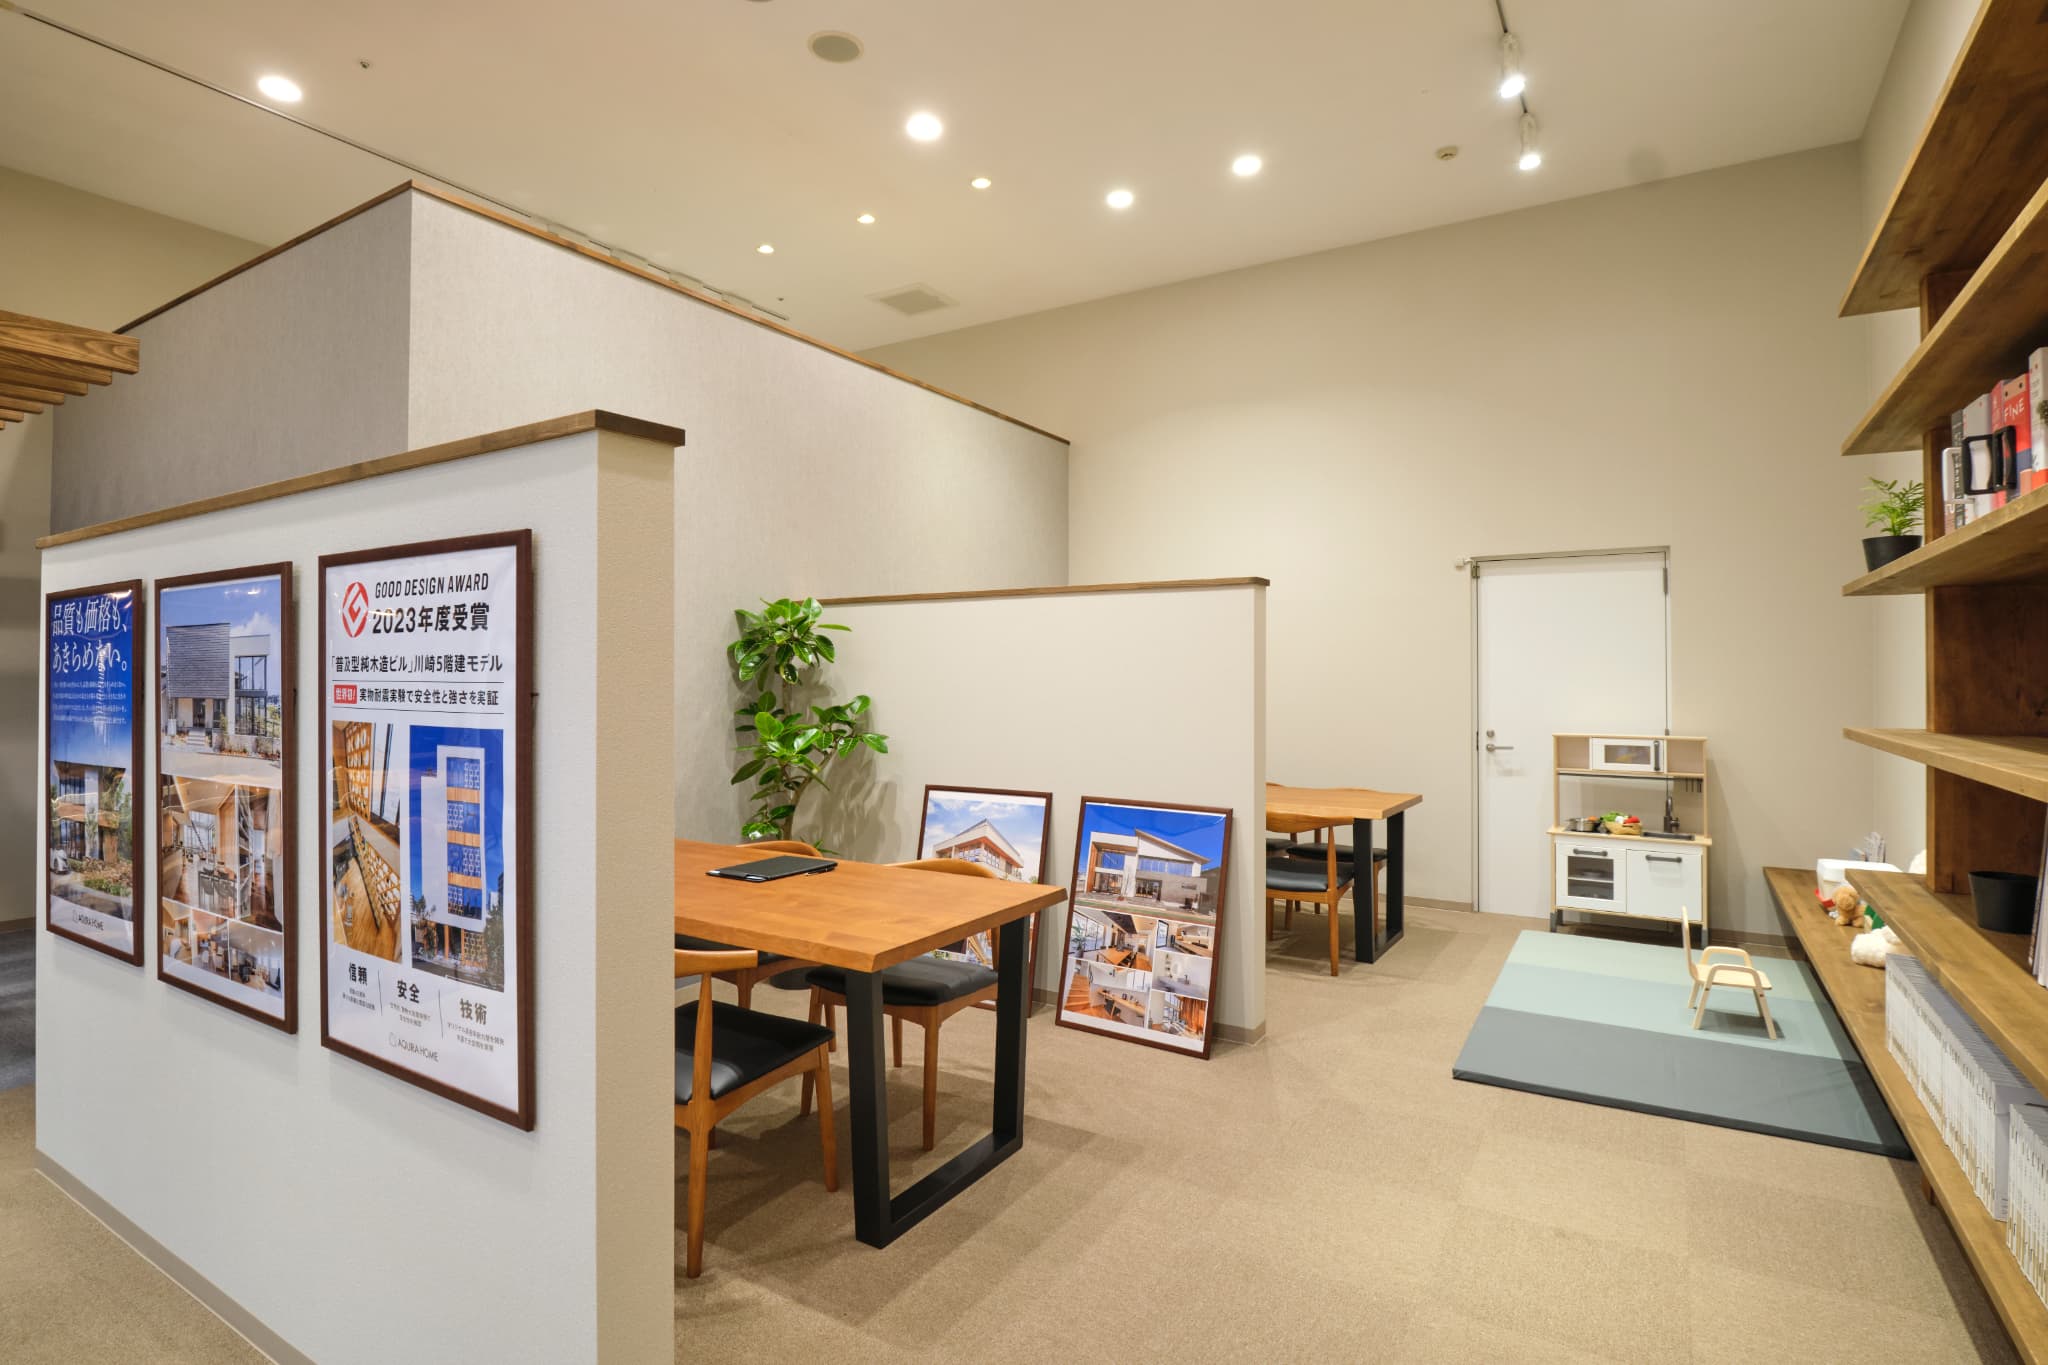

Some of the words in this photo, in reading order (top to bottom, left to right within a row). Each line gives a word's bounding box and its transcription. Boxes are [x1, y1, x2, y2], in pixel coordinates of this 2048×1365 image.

[2003, 398, 2025, 420] FINE
[375, 580, 402, 598] GOOD
[404, 577, 445, 596] DESIGN
[447, 573, 489, 593] AWARD
[52, 597, 127, 636] 品質も価格も、
[373, 602, 490, 634] 2023年度受賞
[52, 639, 127, 674] あきらめない。
[349, 963, 368, 985] 信頼
[397, 980, 420, 1004] 安全
[459, 998, 487, 1025] 技術
